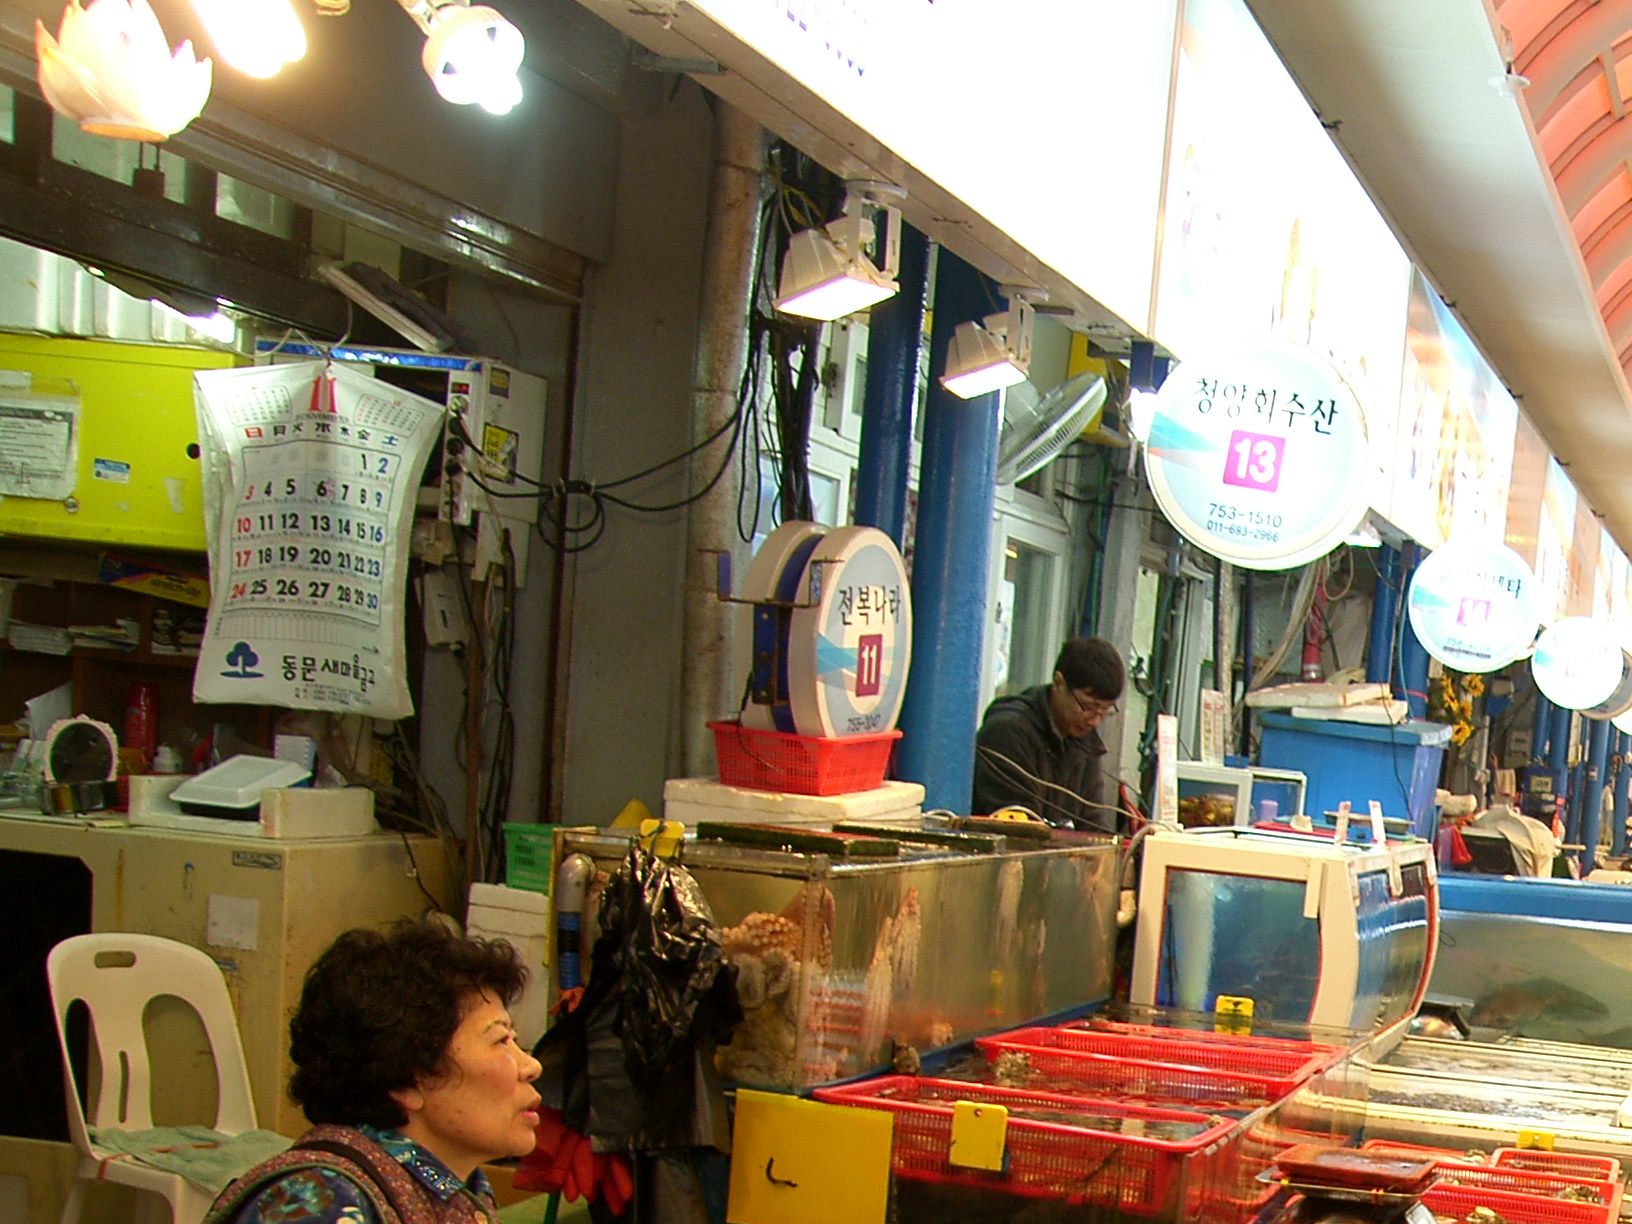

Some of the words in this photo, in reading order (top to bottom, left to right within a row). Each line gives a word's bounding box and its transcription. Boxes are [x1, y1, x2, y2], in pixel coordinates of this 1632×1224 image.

[308, 376, 338, 413] 11
[378, 457, 388, 473] 2
[1235, 438, 1277, 484] 13
[264, 480, 272, 497] 4
[286, 478, 296, 495] 5
[316, 480, 327, 497] 6
[341, 484, 350, 500] 7
[360, 488, 367, 504] 8
[375, 491, 383, 508] 9
[237, 517, 252, 533] 10
[259, 514, 274, 531] 11
[281, 512, 300, 529] 12
[311, 514, 331, 532] 13
[338, 517, 351, 535] 14
[356, 522, 366, 540] 15
[369, 525, 383, 543] 16
[1209, 503, 1283, 528] 753-1510
[236, 550, 251, 567] 17
[258, 548, 272, 564] 18
[279, 546, 299, 562] 19
[309, 548, 331, 565] 20
[338, 552, 351, 569] 21
[354, 556, 365, 573] 22
[367, 559, 380, 577] 23
[231, 583, 247, 599] 24
[251, 580, 267, 595] 25
[276, 580, 299, 596] 26
[308, 582, 330, 598] 27
[337, 585, 351, 603] 28
[355, 587, 364, 605] 29
[367, 592, 378, 609] 30
[838, 585, 901, 626] 전복나라
[862, 644, 877, 685] 11
